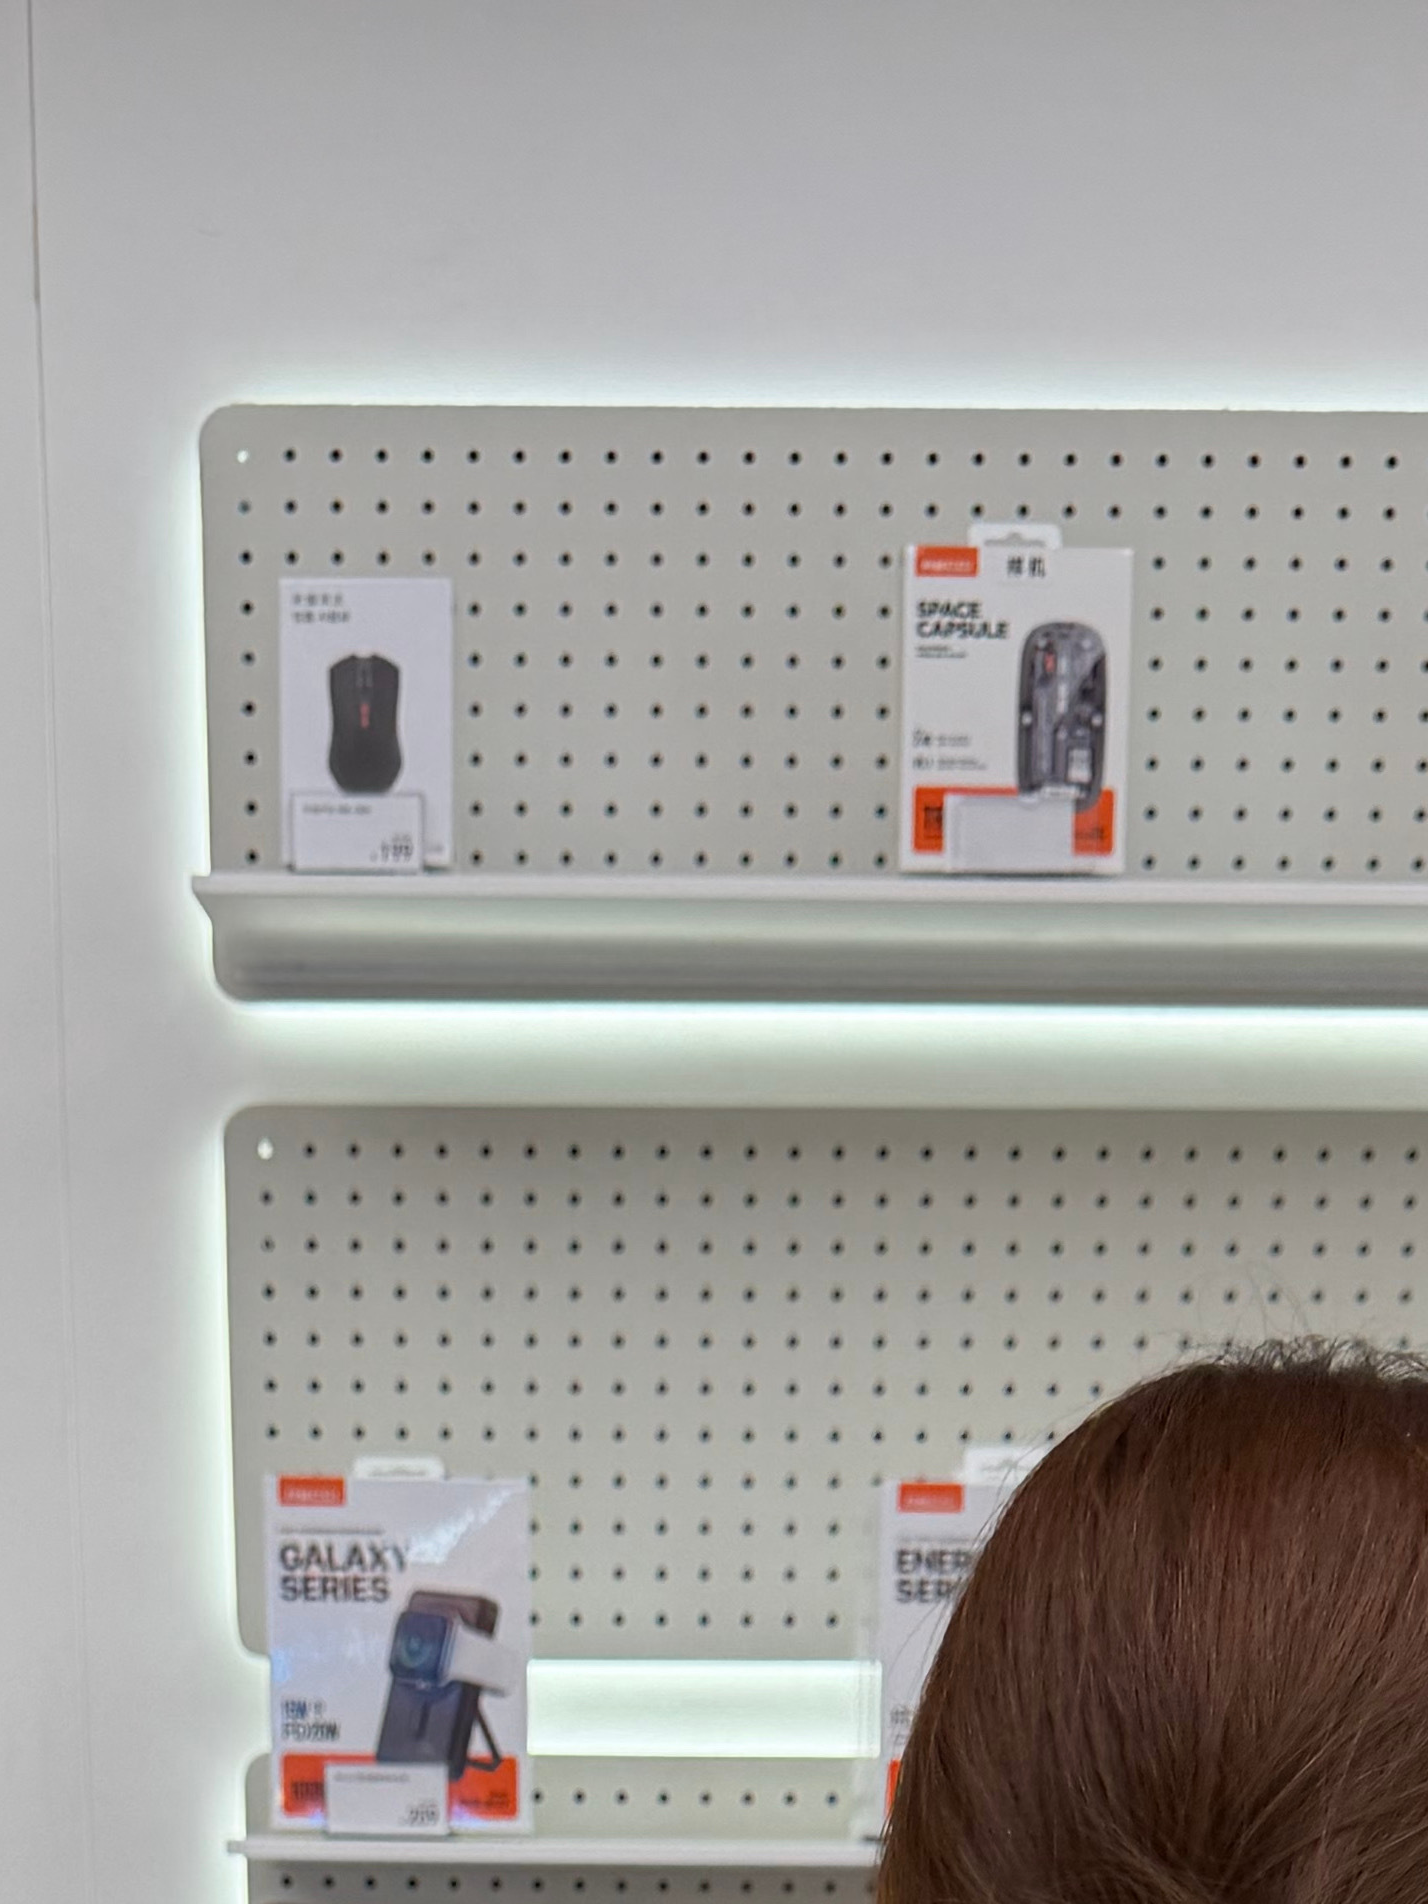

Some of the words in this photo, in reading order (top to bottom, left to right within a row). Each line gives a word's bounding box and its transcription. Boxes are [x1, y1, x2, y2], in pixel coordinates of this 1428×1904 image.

[916, 602, 981, 619] SPACE
[916, 621, 1008, 640] CAPSULE
[279, 1542, 409, 1573] GALAXY
[896, 1549, 973, 1575] ENER
[279, 1575, 391, 1603] SERIES
